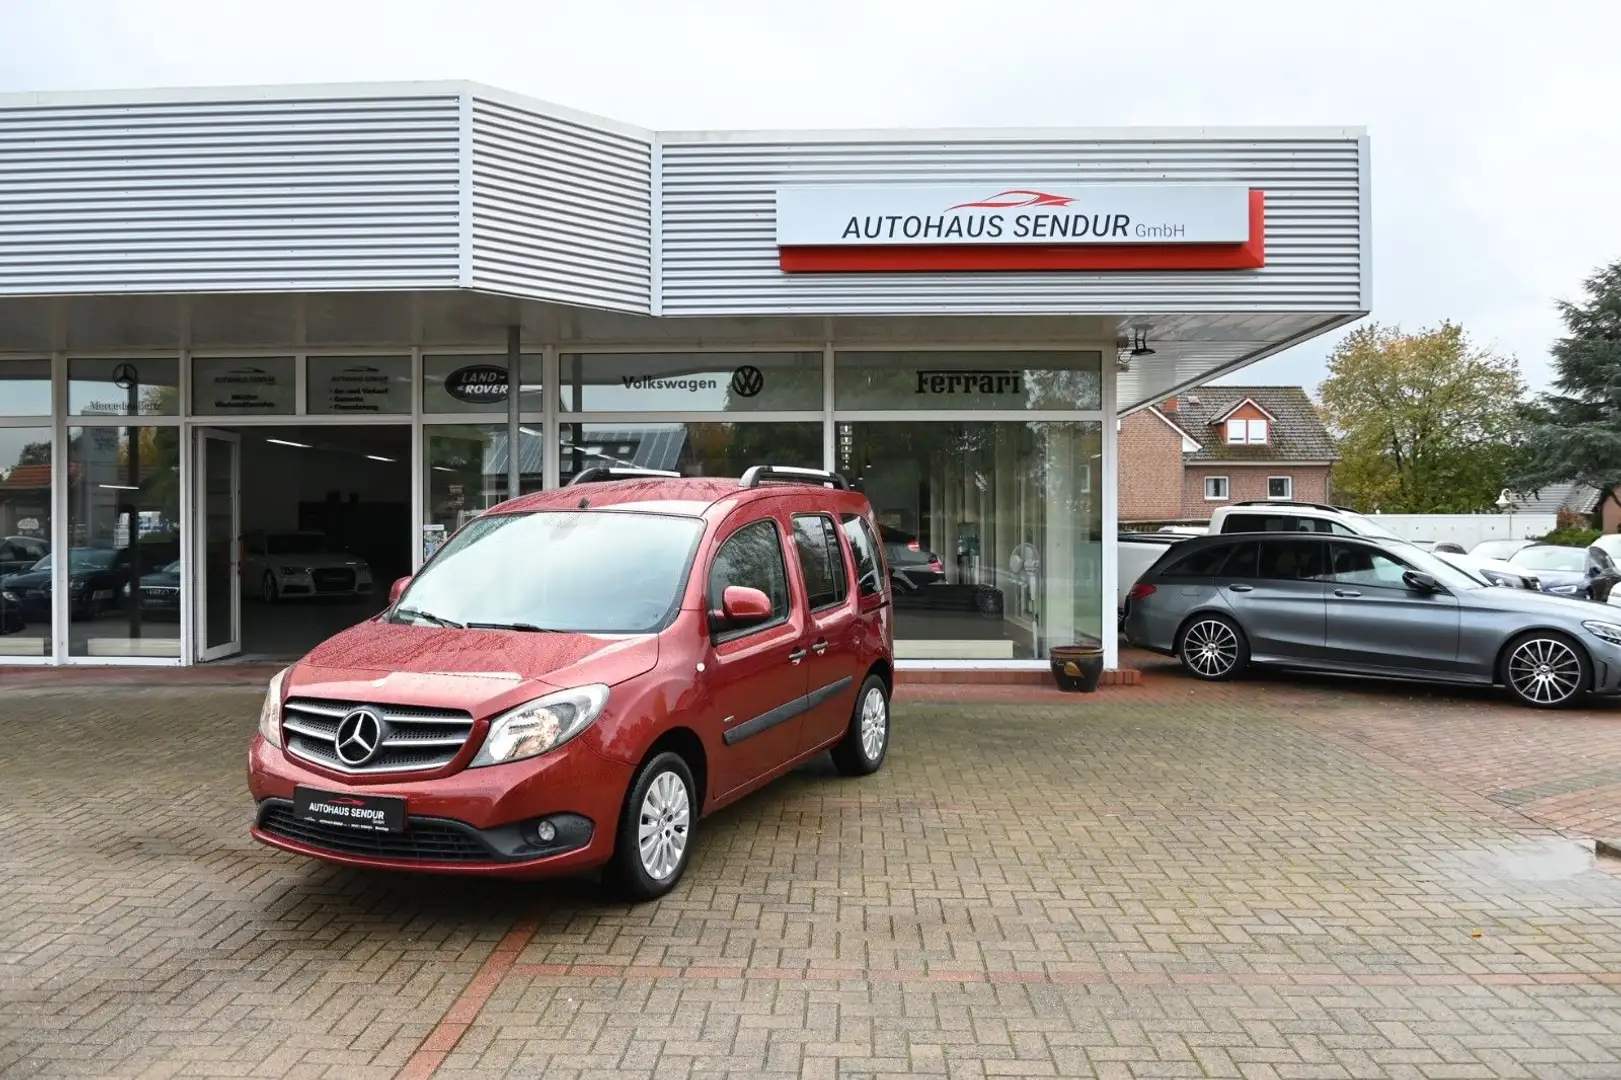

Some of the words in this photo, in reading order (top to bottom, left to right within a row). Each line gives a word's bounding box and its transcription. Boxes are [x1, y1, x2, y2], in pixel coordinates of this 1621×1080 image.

[842, 215, 1004, 238] AUTOHAUS
[1013, 214, 1130, 237] SENDUR
[1135, 223, 1185, 238] GmbH
[622, 375, 717, 393] Volkswagen
[915, 369, 1021, 394] Ferrari
[309, 802, 349, 816] AUTOHAUS
[351, 808, 385, 819] SENDUR
